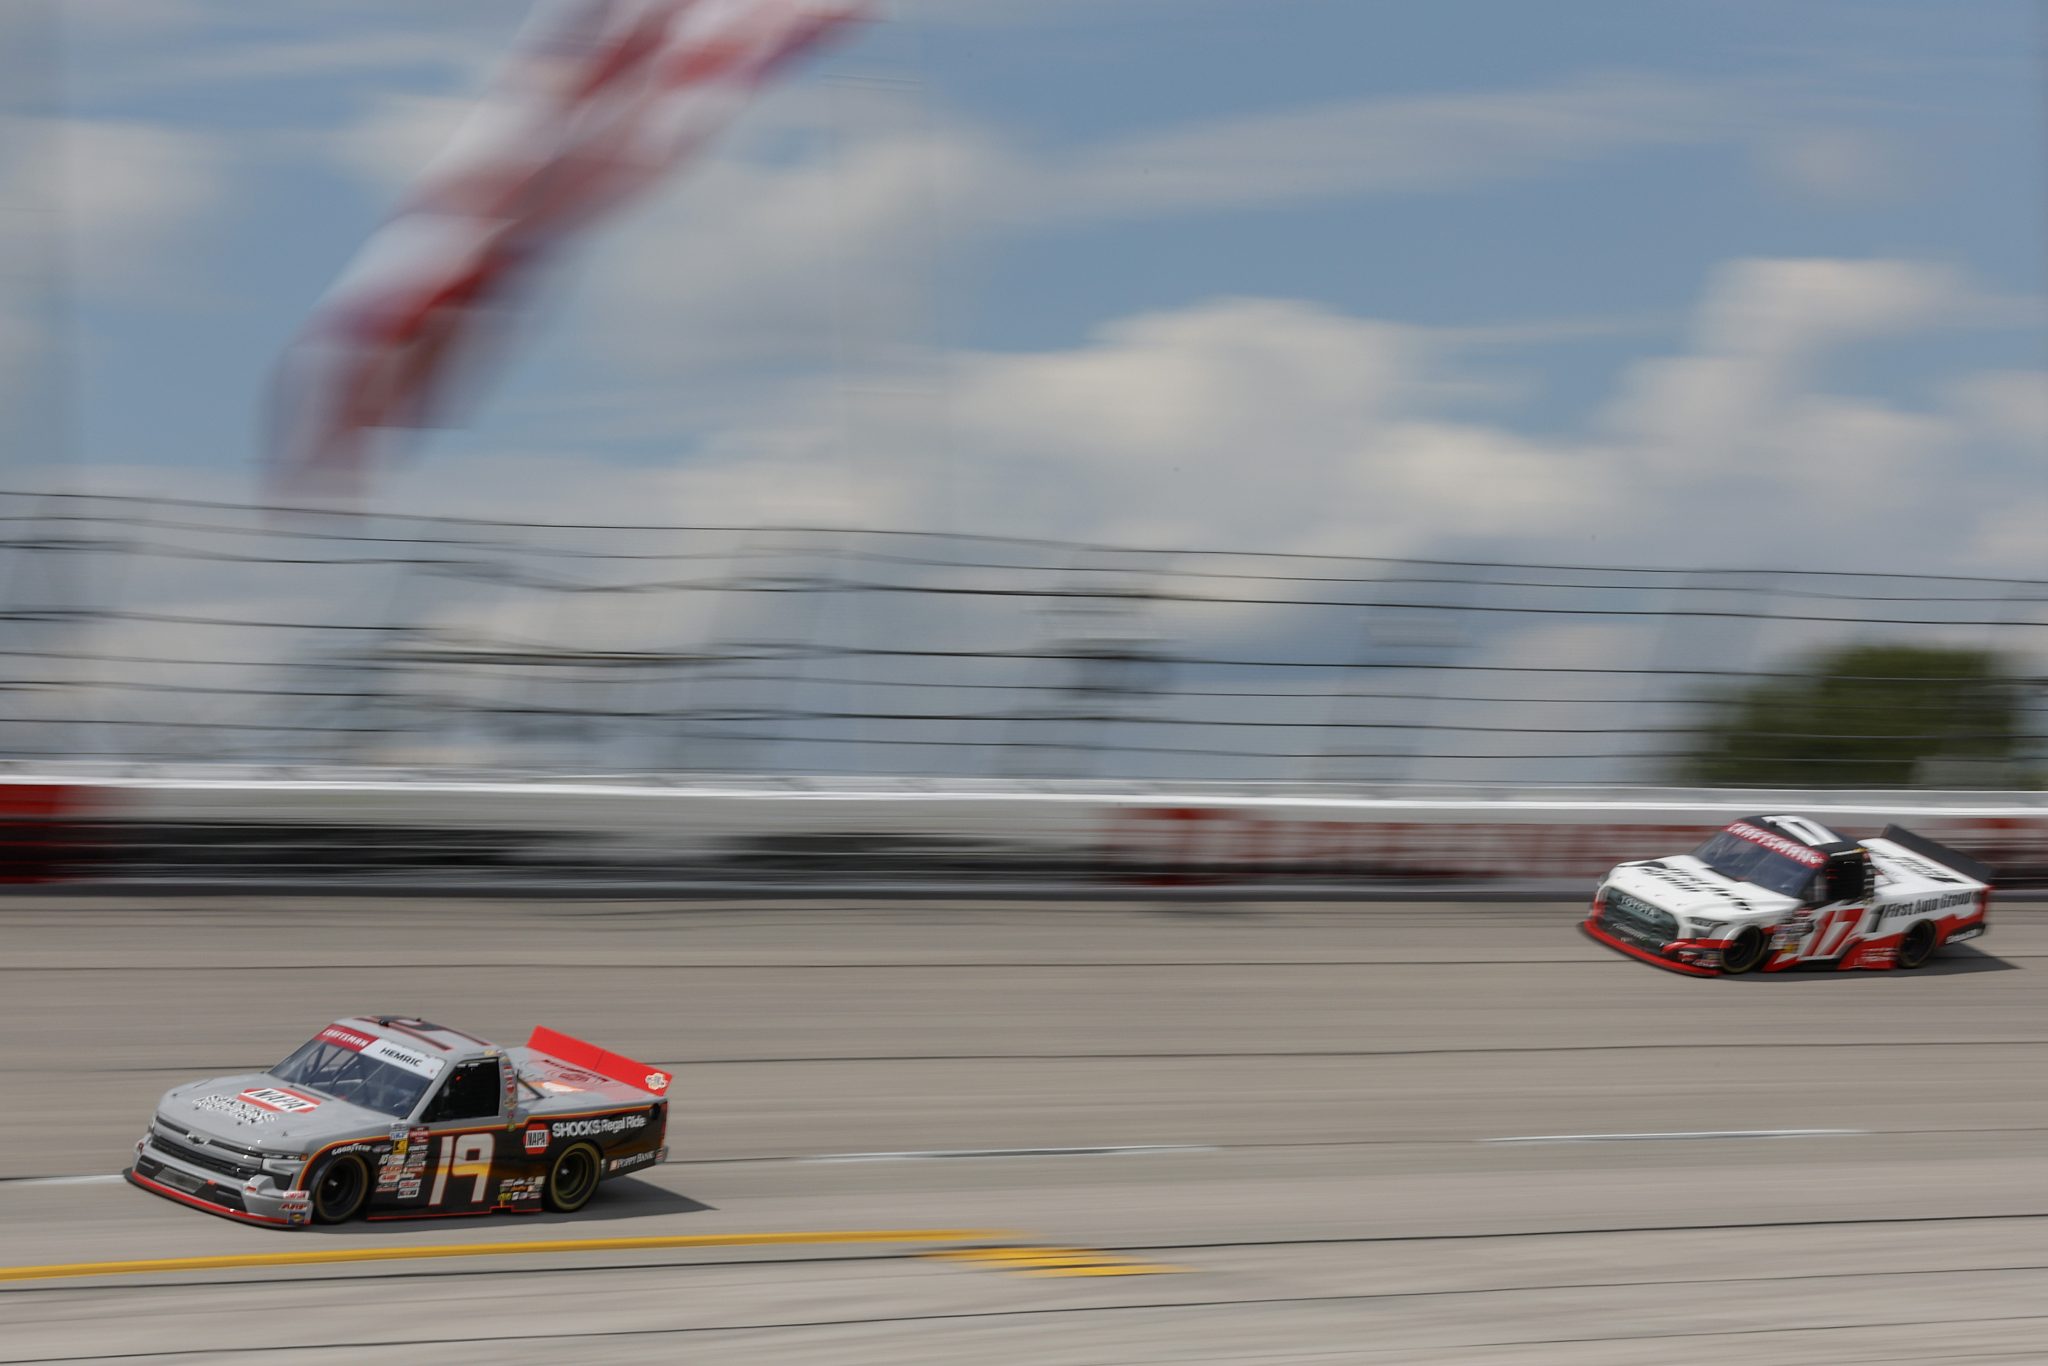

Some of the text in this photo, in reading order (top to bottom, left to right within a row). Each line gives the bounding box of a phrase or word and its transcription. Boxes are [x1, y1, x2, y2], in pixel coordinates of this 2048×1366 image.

[1617, 895, 1657, 918] TOYOTA
[1884, 892, 1971, 918] First Auto Group
[1803, 908, 1866, 957] 17
[322, 1028, 369, 1047] CRAFTSMAN
[379, 1047, 423, 1067] HEMRIC
[247, 1090, 308, 1110] NAPA
[552, 1114, 647, 1137] SHOCKS Regal Ride
[331, 1143, 373, 1156] GOODYEAR
[527, 1131, 547, 1147] NAPA
[428, 1132, 495, 1206] 19
